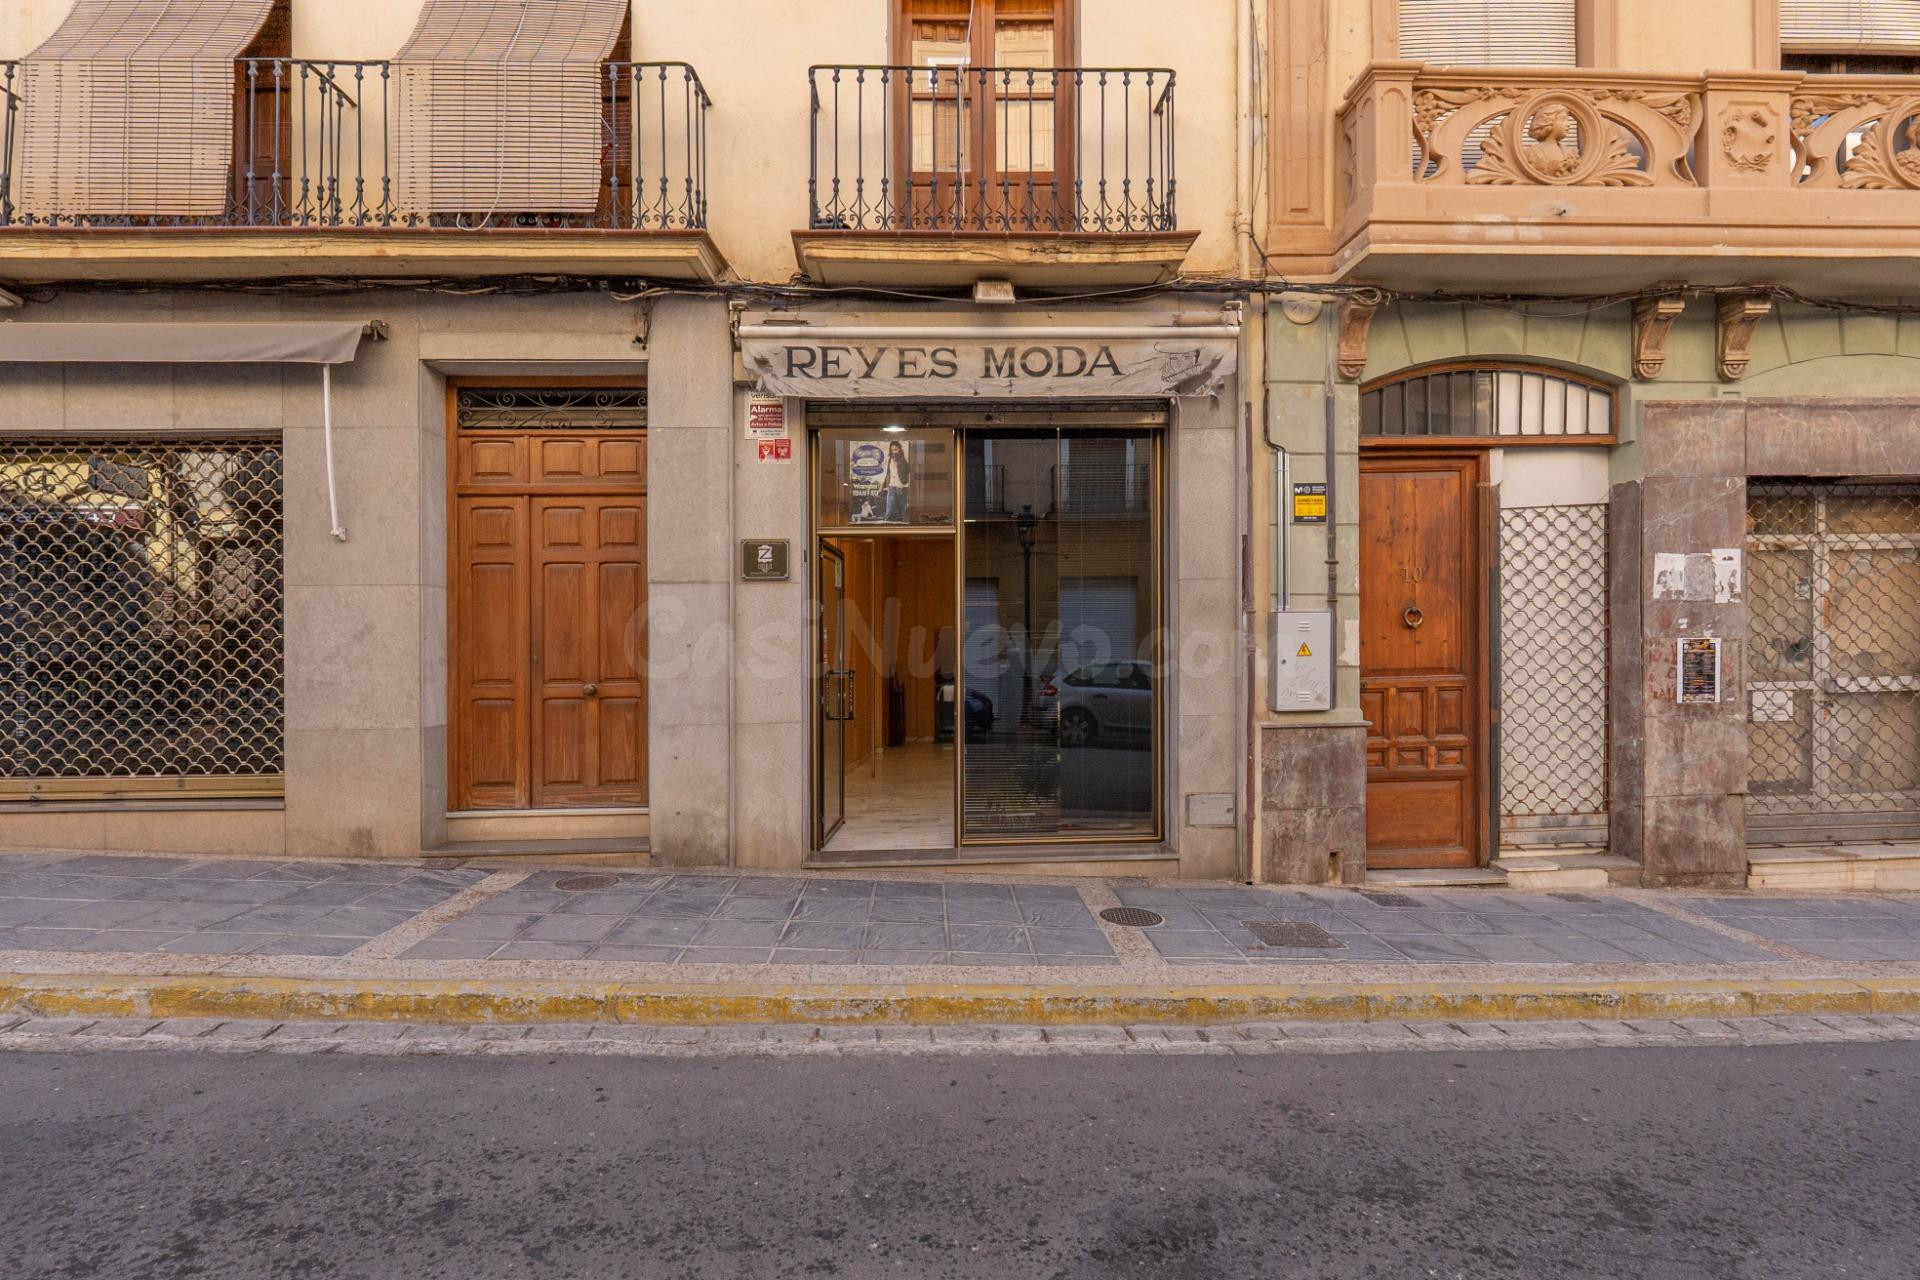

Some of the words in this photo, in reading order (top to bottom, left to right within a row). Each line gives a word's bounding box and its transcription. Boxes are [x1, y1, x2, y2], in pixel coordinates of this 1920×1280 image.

[783, 346, 958, 379] REYES
[979, 346, 1125, 379] MODA
[750, 405, 782, 413] Alarma
